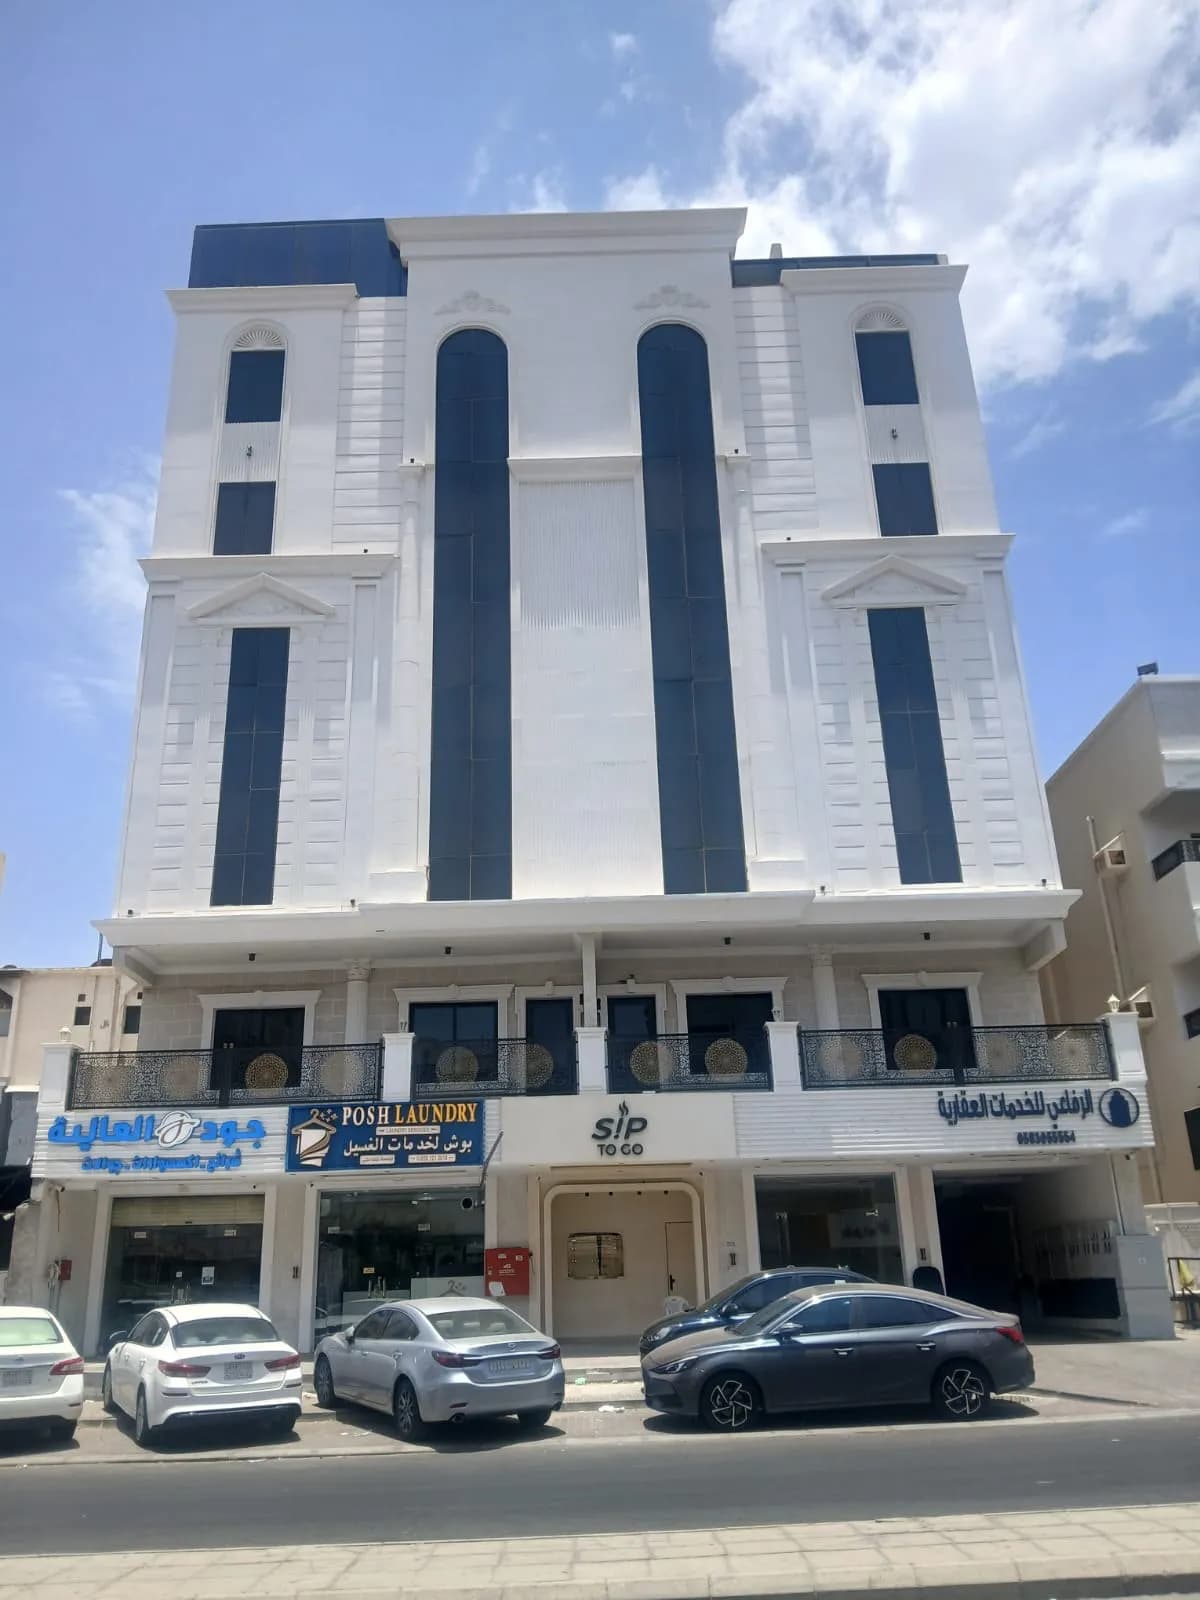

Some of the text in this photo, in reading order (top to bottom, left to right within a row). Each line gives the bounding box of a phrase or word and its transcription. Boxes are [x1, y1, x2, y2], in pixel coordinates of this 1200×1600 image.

[341, 1103, 478, 1126] POSH LAUNDRY
[938, 1090, 988, 1126] العقارية
[47, 1114, 266, 1152] جود العالية
[443, 1134, 473, 1153] بوش
[343, 1136, 384, 1157] الغسيل
[597, 1143, 644, 1156] TO GO
